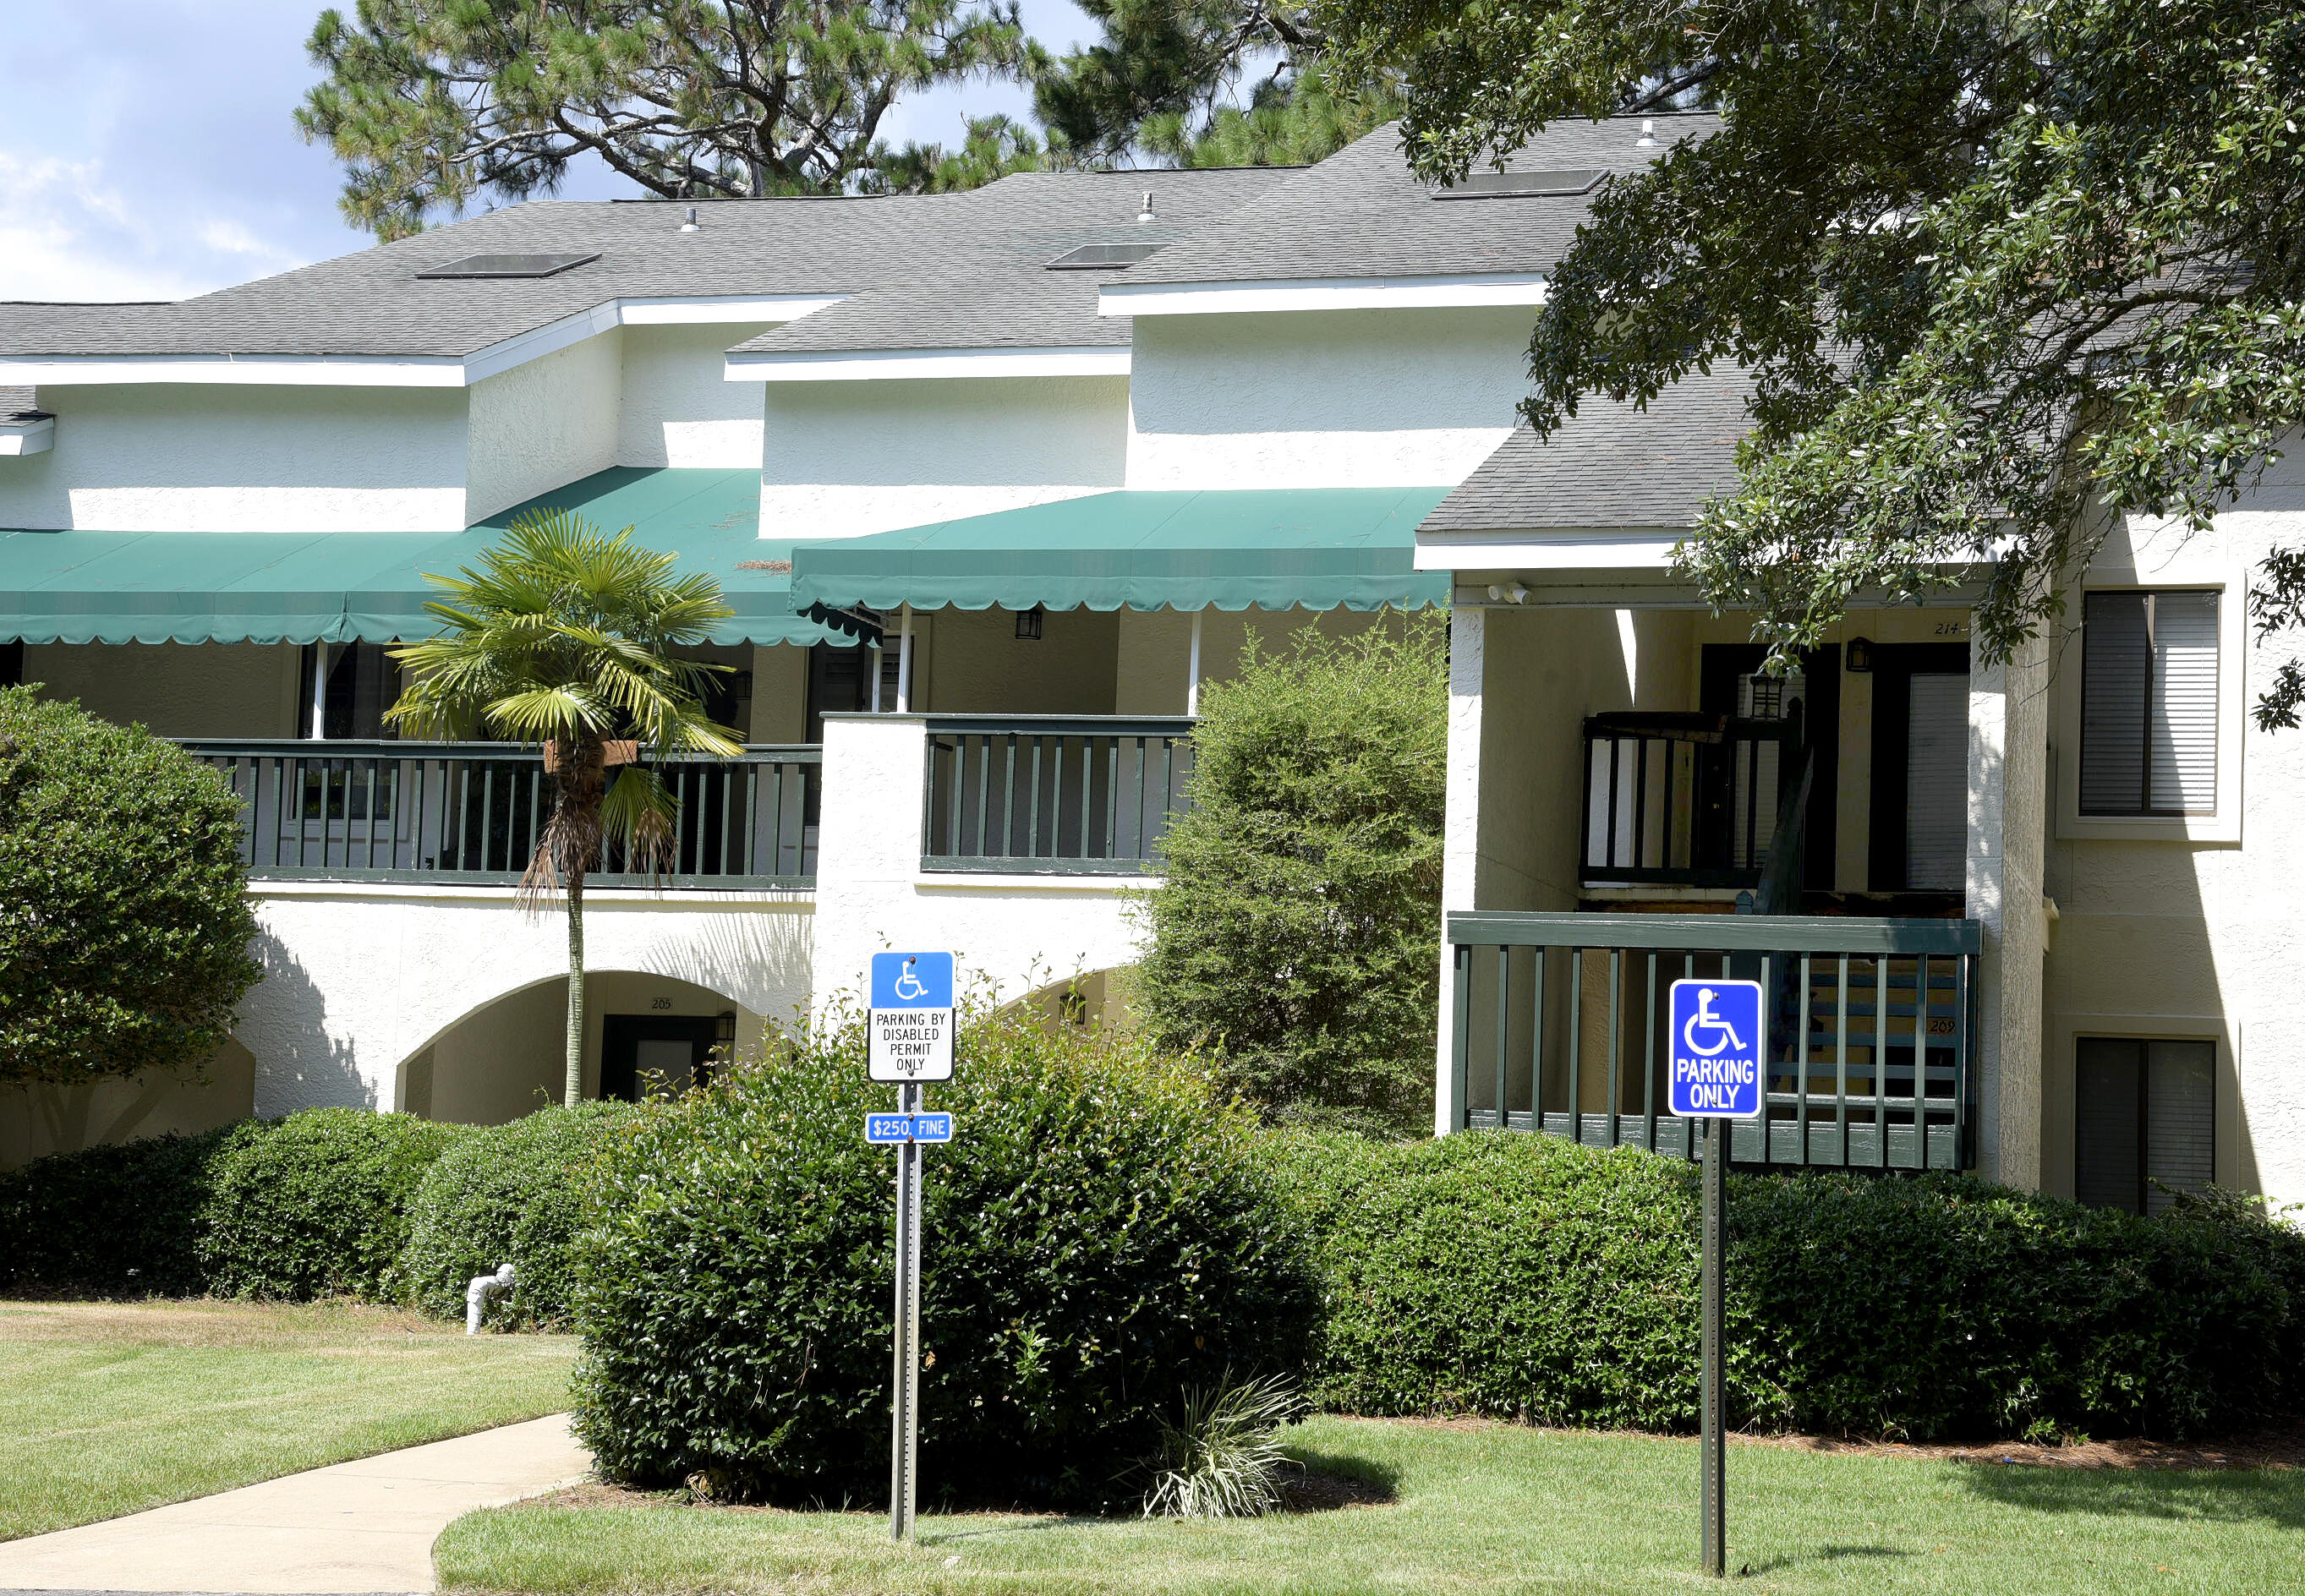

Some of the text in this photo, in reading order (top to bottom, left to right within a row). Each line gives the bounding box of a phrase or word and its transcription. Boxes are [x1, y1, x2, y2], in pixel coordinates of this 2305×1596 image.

[1935, 623, 1958, 635] 214
[652, 999, 671, 1009] 205
[877, 1014, 945, 1025] PARKING BY
[1930, 1020, 1956, 1033] 209
[884, 1029, 939, 1041] DISABLED
[890, 1043, 932, 1056] PERMIT
[896, 1058, 925, 1071] ONLY
[1677, 1058, 1755, 1085] PARKING
[1690, 1083, 1740, 1109] ONLY
[919, 1120, 946, 1135] FINE
